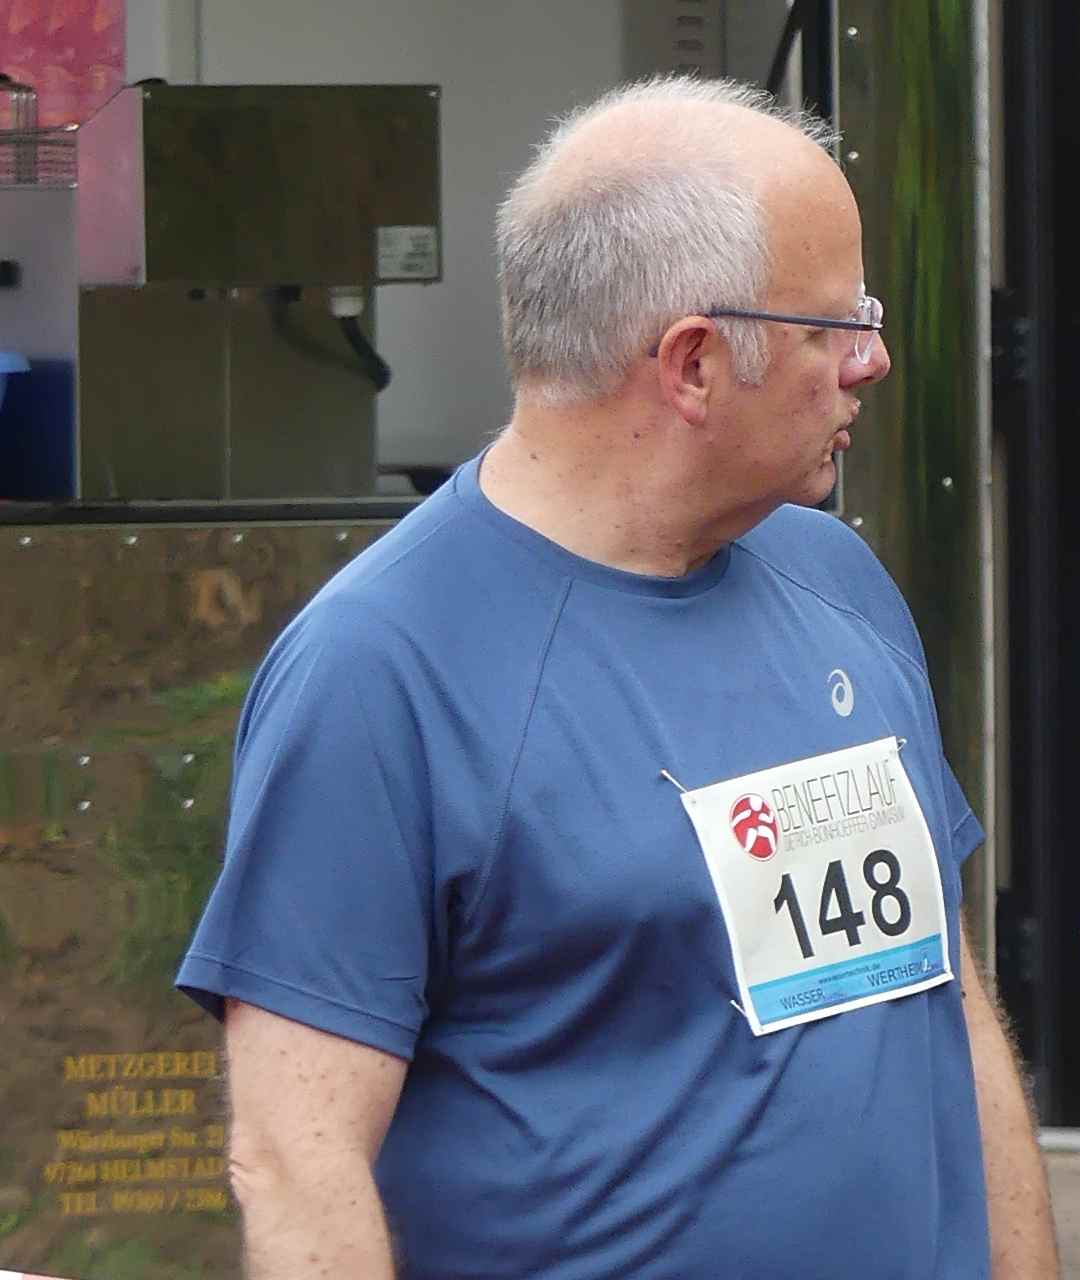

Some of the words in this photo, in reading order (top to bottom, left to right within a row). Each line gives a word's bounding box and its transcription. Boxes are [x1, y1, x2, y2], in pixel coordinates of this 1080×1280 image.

[771, 758, 897, 833] BENEFIZLAUF
[773, 848, 911, 960] 148
[780, 988, 826, 1010] WASSER
[866, 963, 925, 987] WERTHEIM
[64, 1051, 216, 1081] METZGEREI
[84, 1086, 196, 1118] MÜLLER
